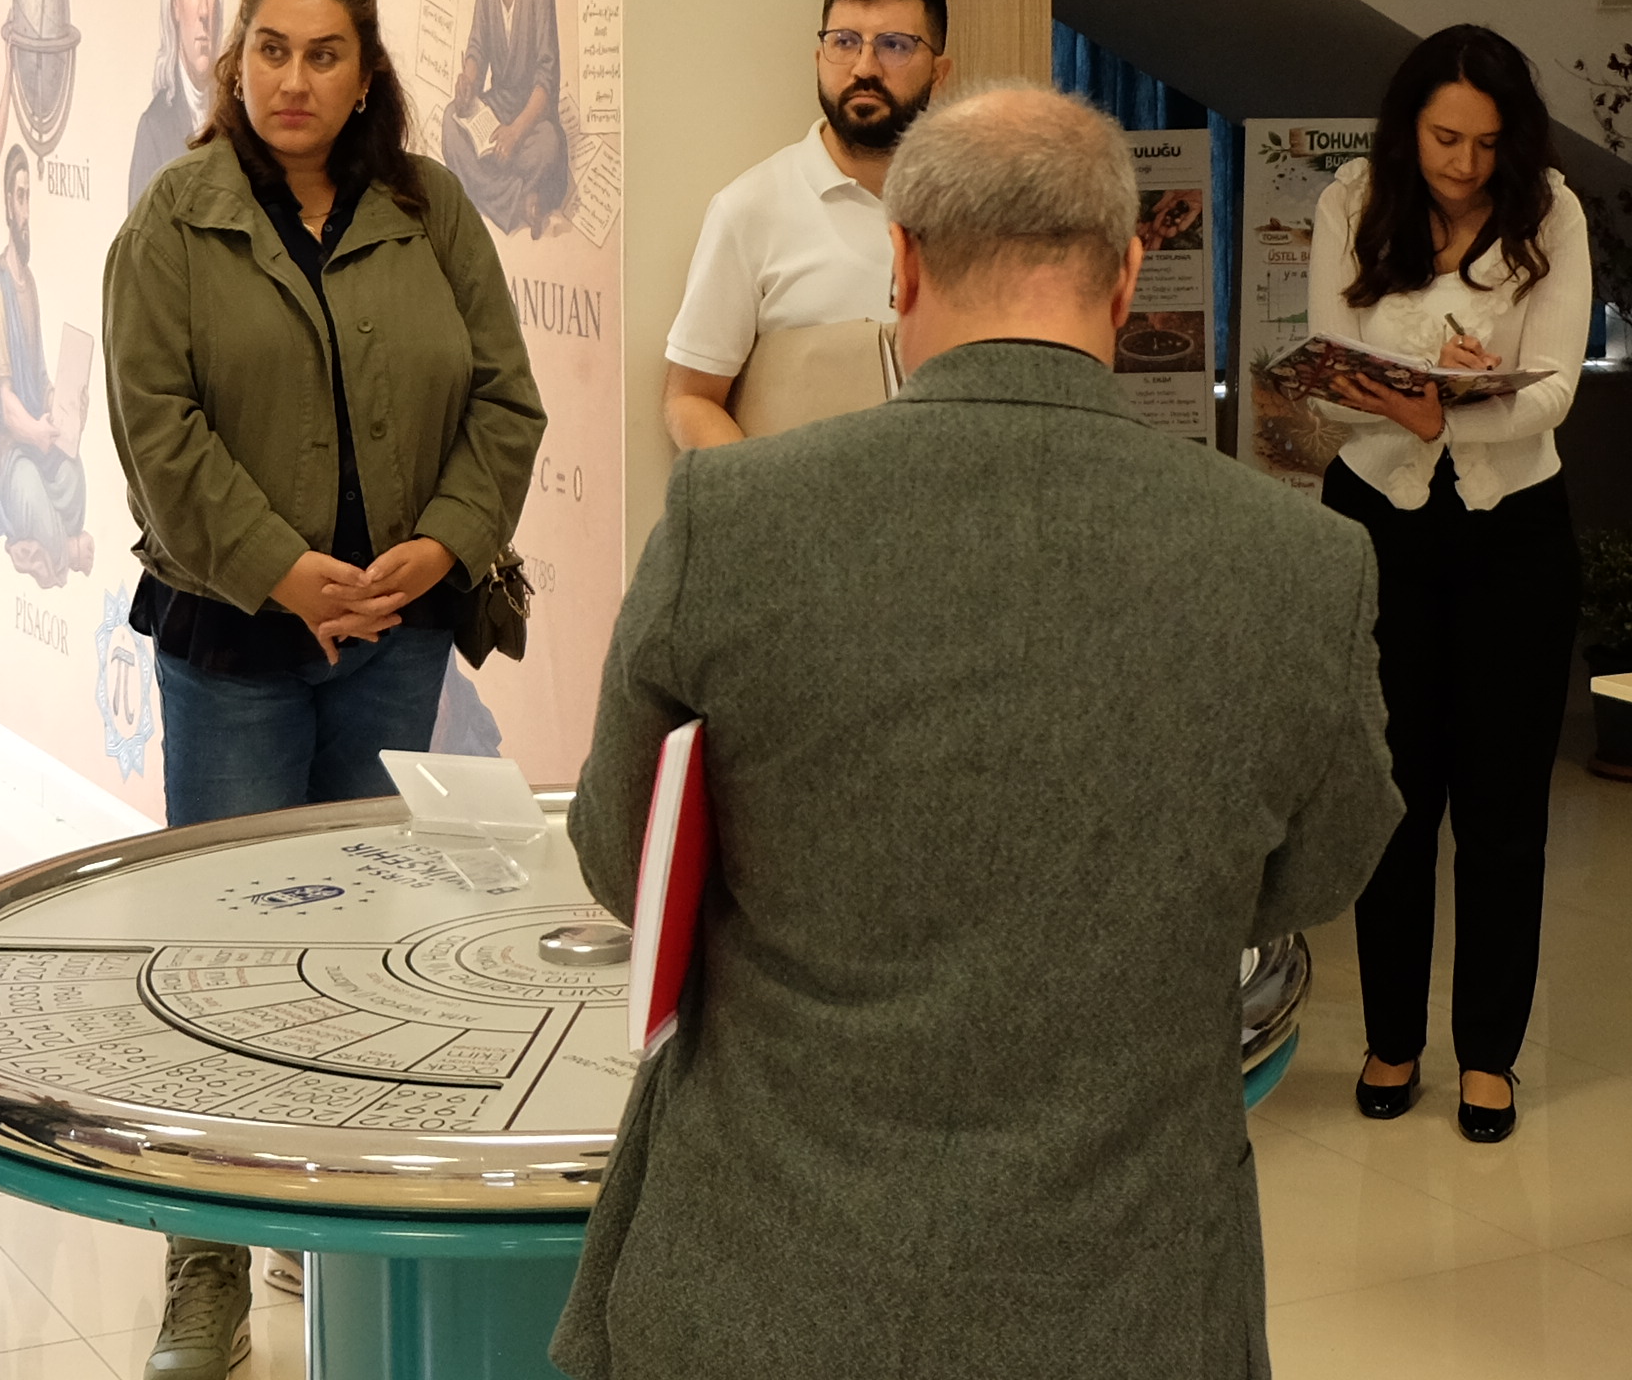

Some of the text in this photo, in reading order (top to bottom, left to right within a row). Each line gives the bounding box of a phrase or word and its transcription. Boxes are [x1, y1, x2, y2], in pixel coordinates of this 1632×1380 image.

[1132, 143, 1181, 158] ULUĞU
[1305, 131, 1374, 151] TOHUM
[46, 156, 90, 202] BİRUNİ
[1268, 249, 1297, 261] ÜSTEL
[511, 275, 602, 341] ANUJAN
[14, 593, 70, 657] PİSAGOR
[7, 983, 45, 1015] 2035
[19, 1018, 75, 1049] 2041
[8, 1058, 90, 1088] 1997
[166, 1065, 254, 1094] 1998
[200, 1057, 281, 1083] 1970
[420, 1061, 501, 1076] Ocak
[129, 1077, 227, 1105] 2037
[396, 1089, 489, 1105] 1966
[238, 1100, 344, 1121] 2021
[374, 1100, 481, 1118] 1994
[358, 1113, 478, 1132] 2022
